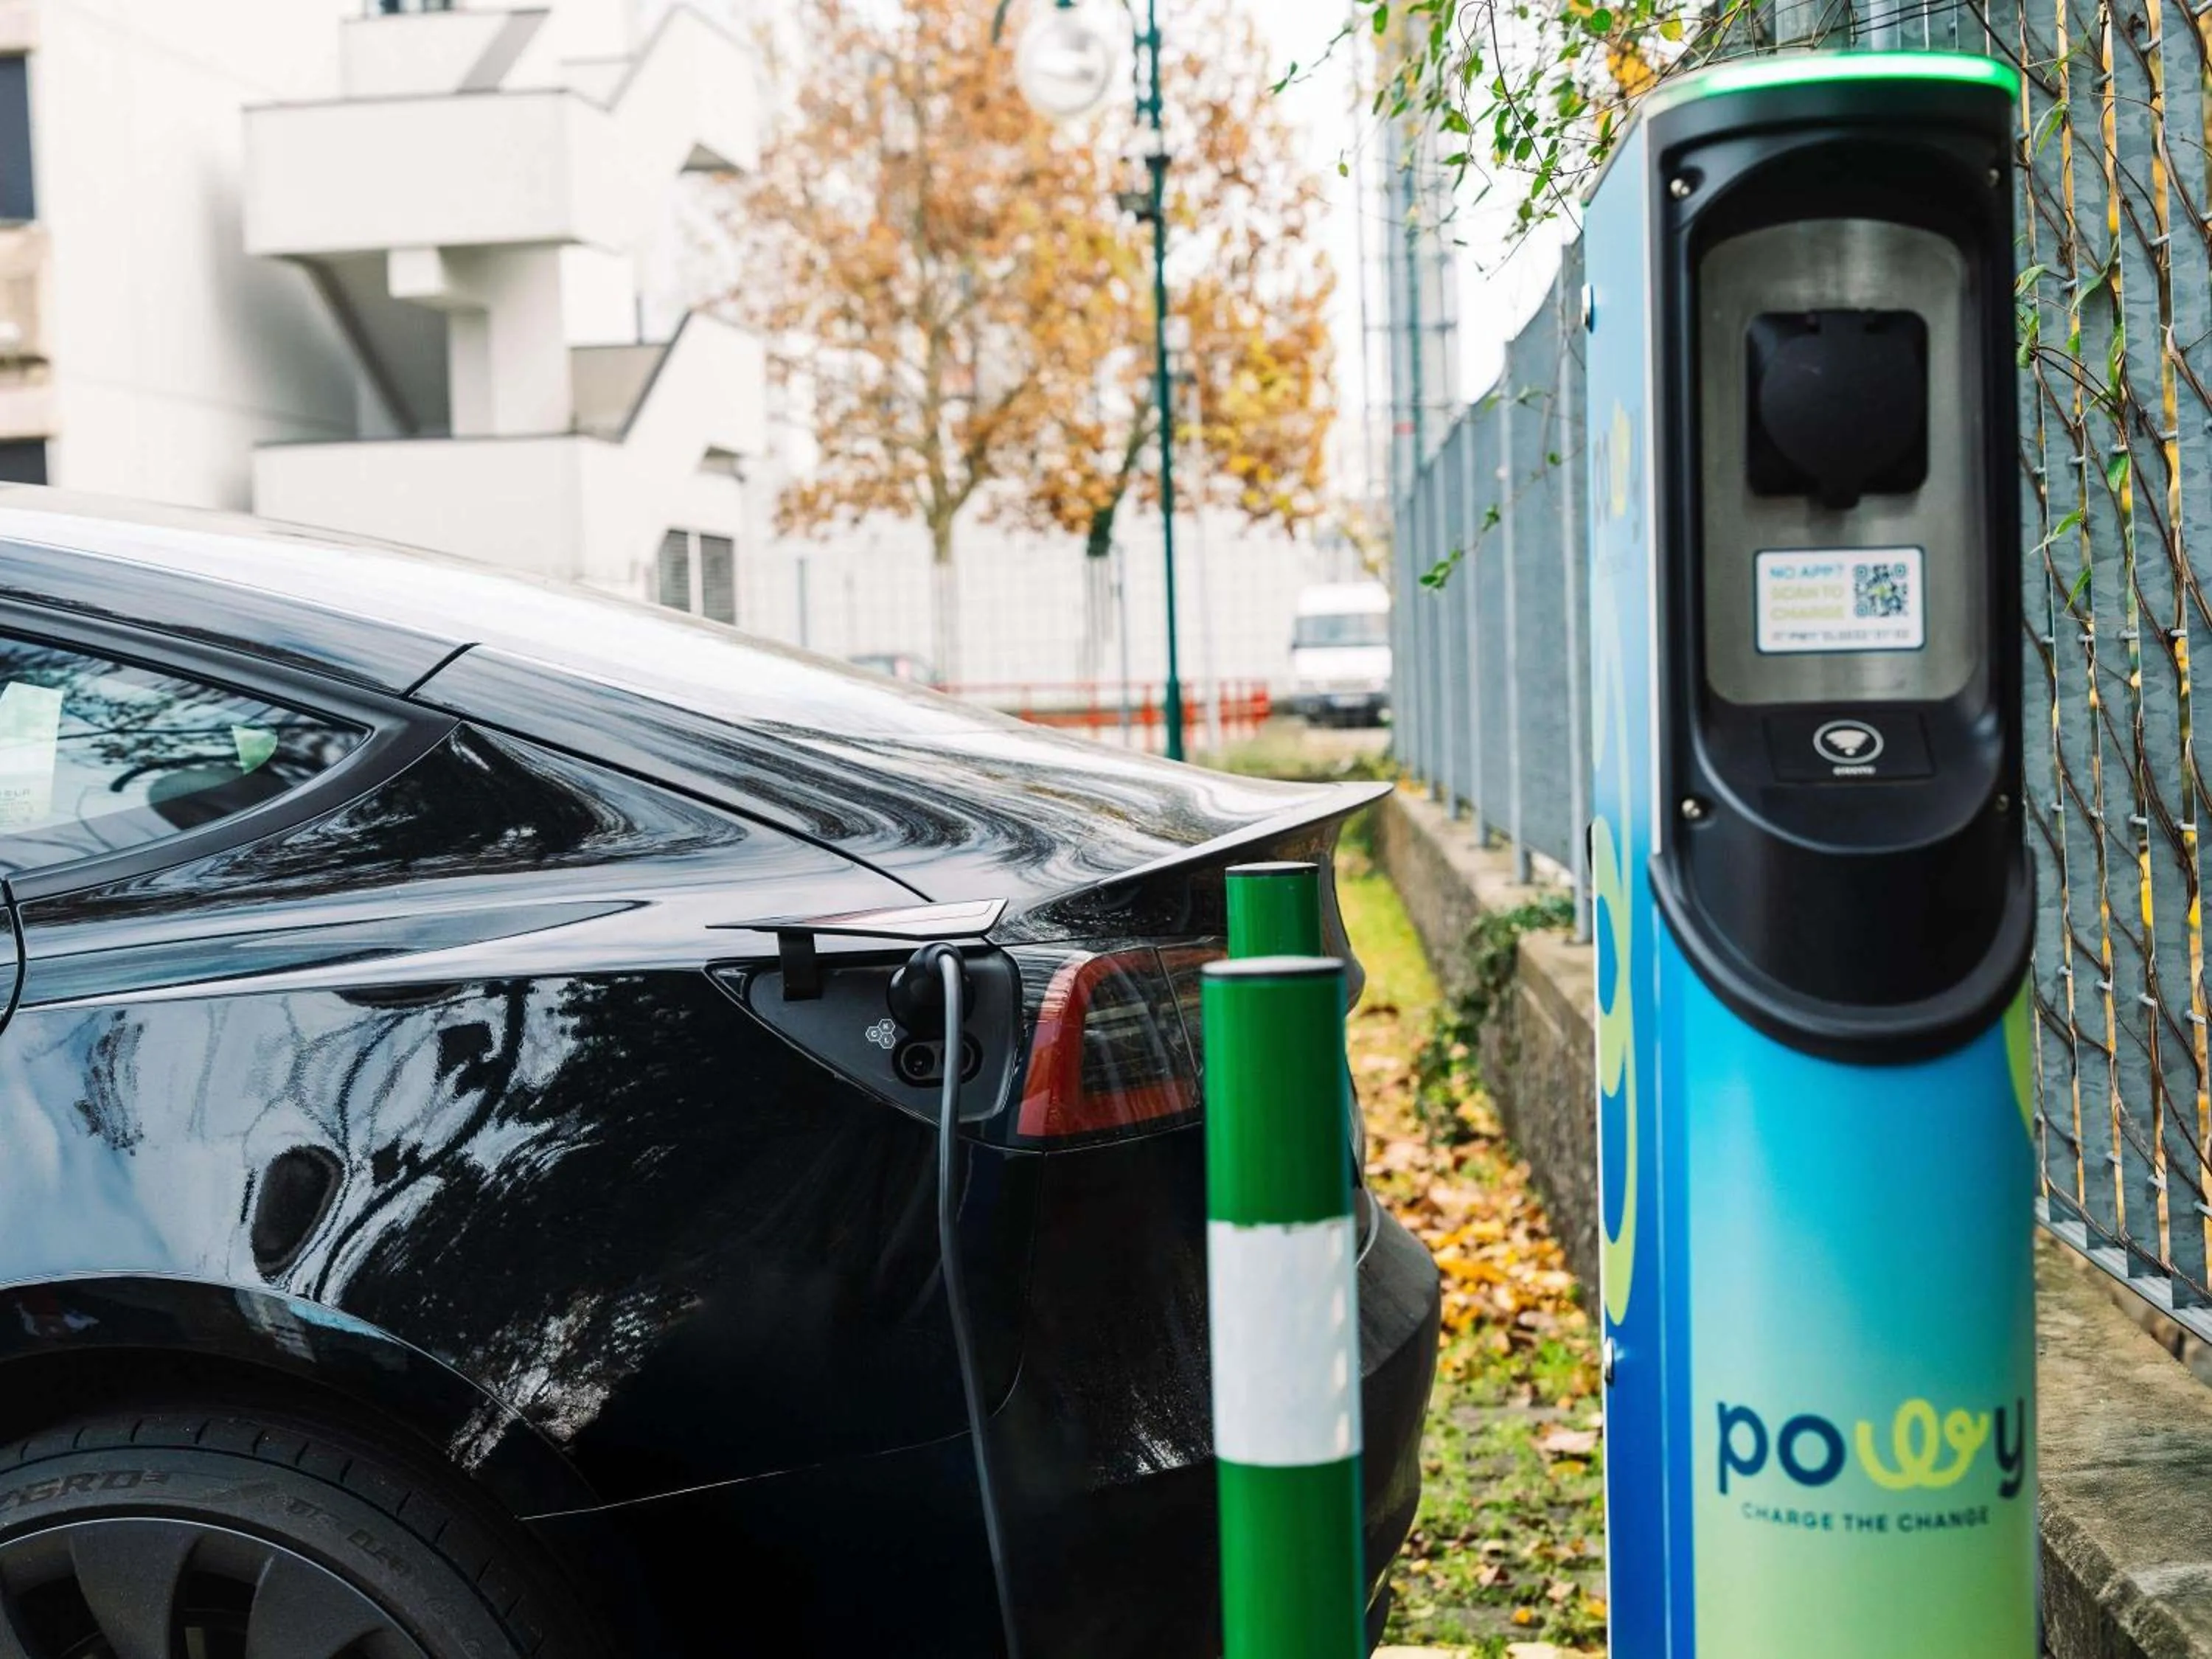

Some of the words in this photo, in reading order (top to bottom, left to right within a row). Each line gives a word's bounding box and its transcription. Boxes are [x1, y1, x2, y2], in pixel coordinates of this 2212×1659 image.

[1740, 1502, 1833, 1531] CHARGE
[1843, 1513, 1888, 1532] THE
[1897, 1506, 1989, 1533] CHANGE
